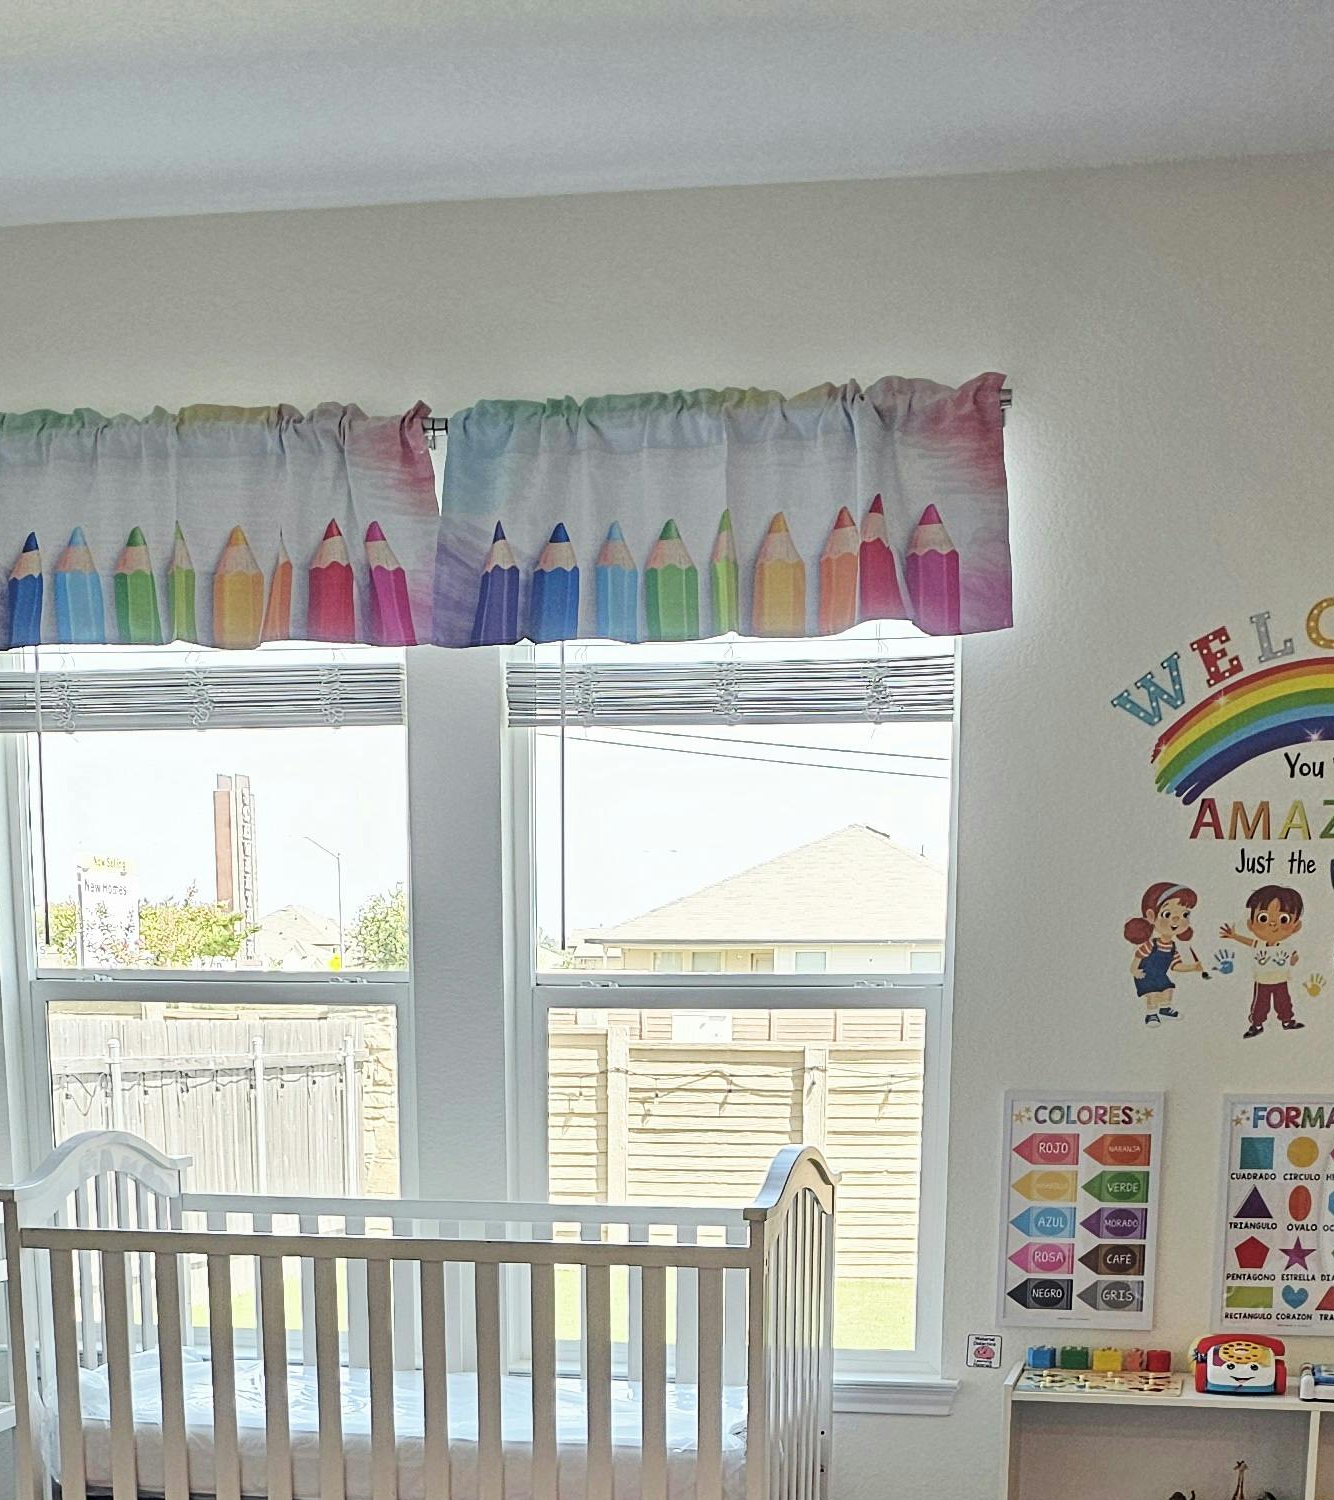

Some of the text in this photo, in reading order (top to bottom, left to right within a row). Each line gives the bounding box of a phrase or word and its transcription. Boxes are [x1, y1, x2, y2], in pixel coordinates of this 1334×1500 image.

[1234, 849, 1275, 875] Just
[1288, 851, 1317, 874] the
[1034, 1105, 1134, 1125] COLORES
[1039, 1142, 1068, 1154] ROJO
[1230, 1172, 1277, 1181] CUADRADO
[1107, 1183, 1138, 1193] VERDE
[1037, 1216, 1065, 1228] AZUL
[1104, 1219, 1138, 1228] MORADO
[1034, 1252, 1064, 1263] ROSA
[1280, 1274, 1316, 1282] ESTRELLA
[1031, 1288, 1063, 1299] NEGRO
[1102, 1290, 1133, 1301] GRIS
